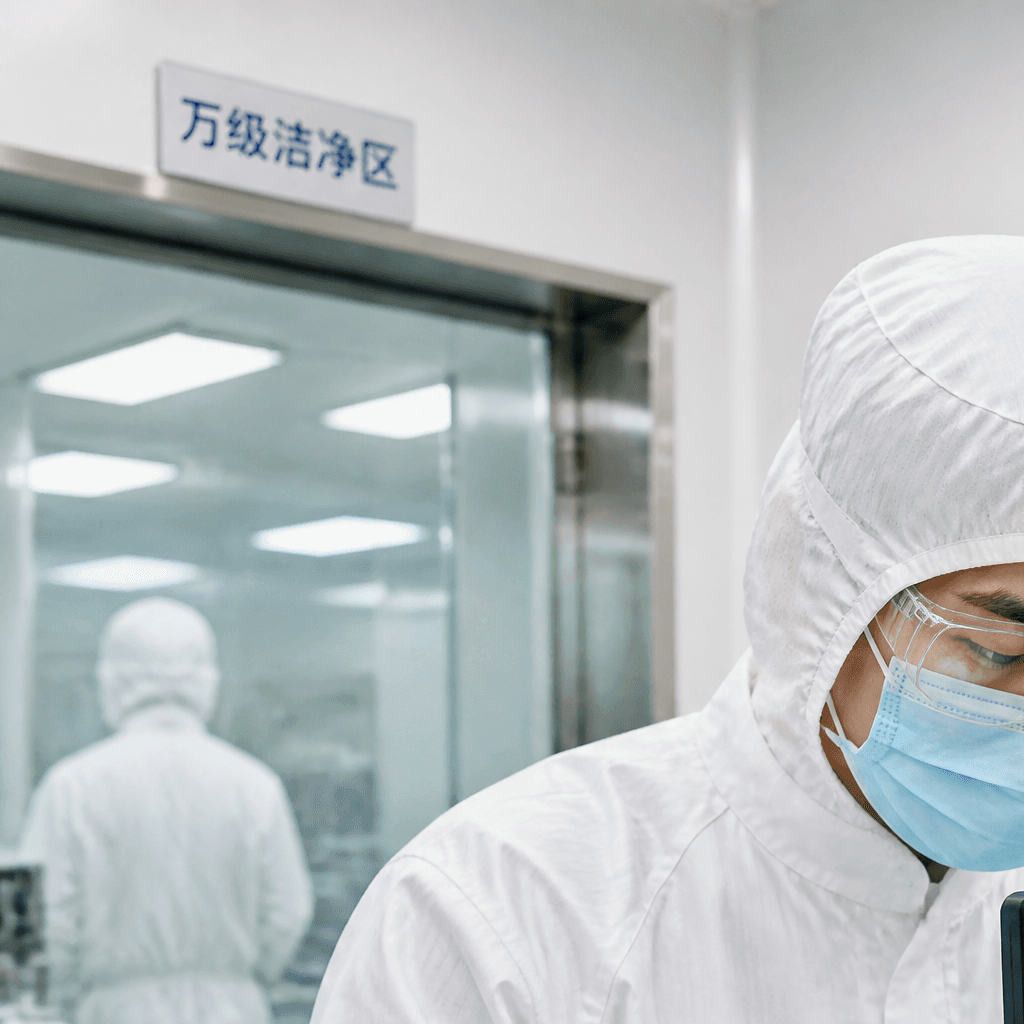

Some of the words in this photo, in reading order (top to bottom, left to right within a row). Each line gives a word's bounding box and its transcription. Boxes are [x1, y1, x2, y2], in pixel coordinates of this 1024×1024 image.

[180, 97, 397, 189] 万级洁净区
